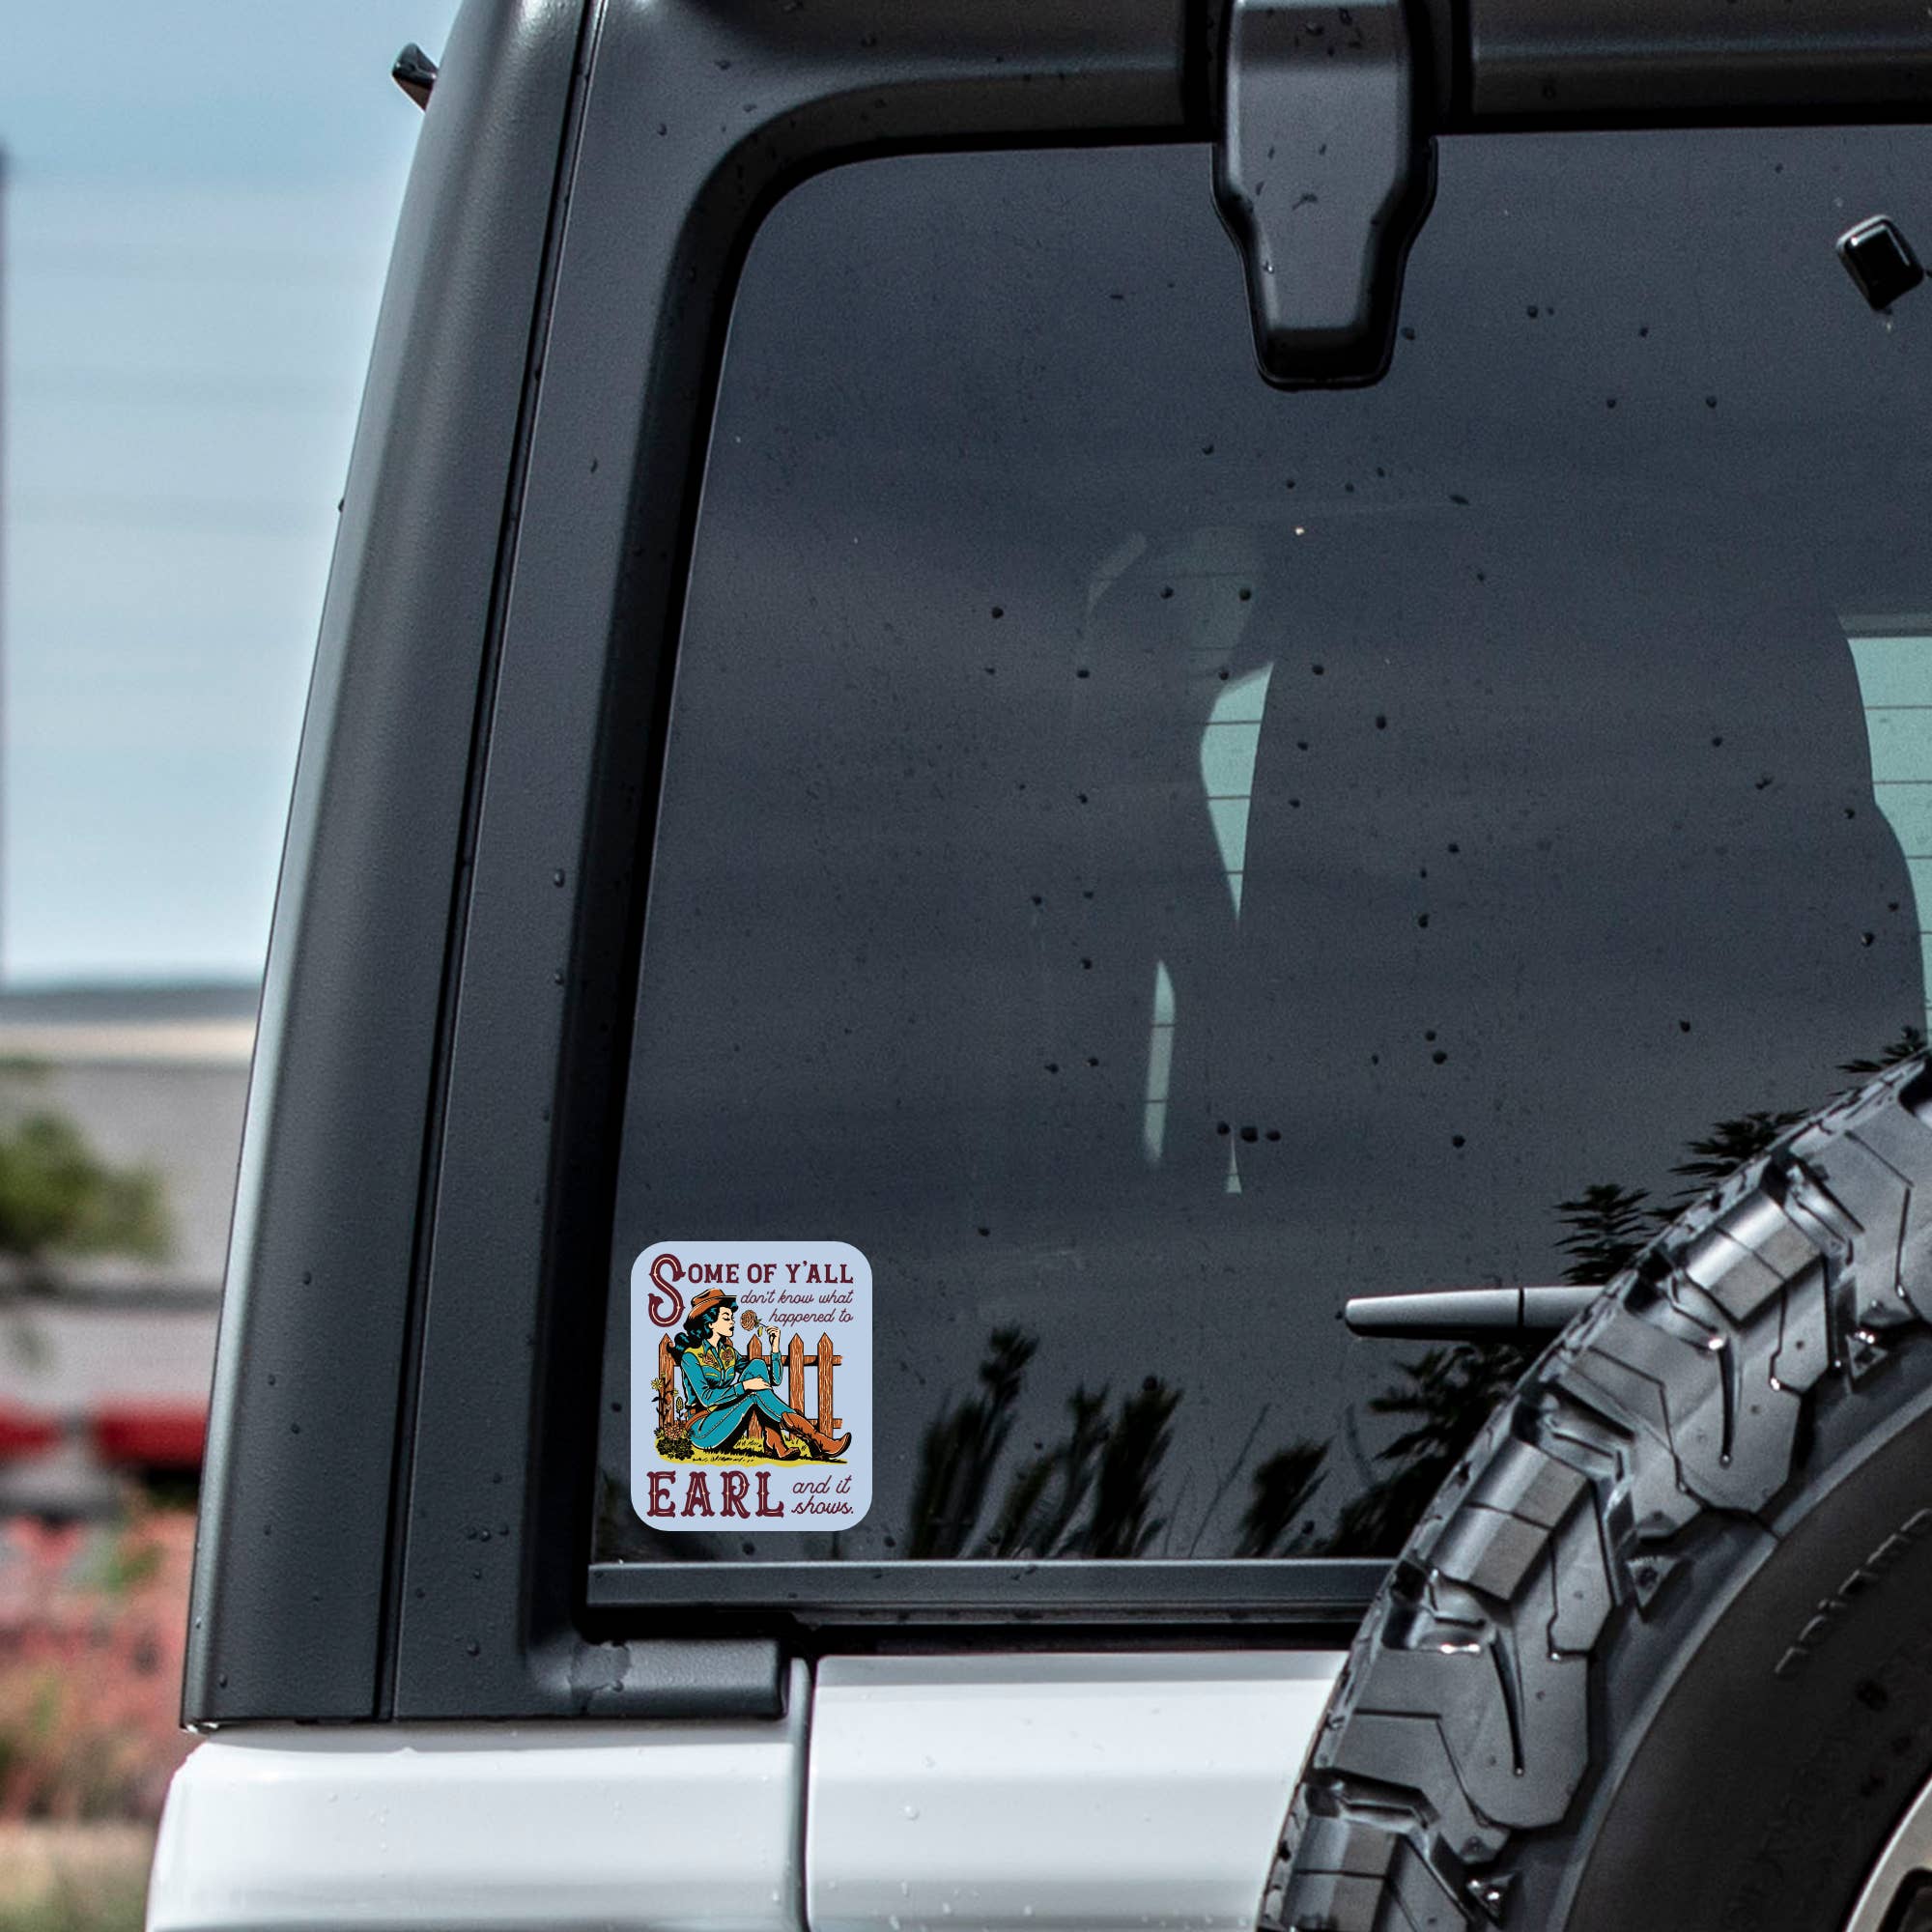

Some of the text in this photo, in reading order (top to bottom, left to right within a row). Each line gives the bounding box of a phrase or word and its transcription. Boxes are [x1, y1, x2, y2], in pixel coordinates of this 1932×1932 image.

[747, 1263, 778, 1284] OF
[778, 1290, 815, 1304] know
[818, 1290, 852, 1304] what
[768, 1308, 854, 1327] happened to
[646, 1470, 785, 1519] EARL
[792, 1475, 851, 1494] and it
[791, 1495, 854, 1516] shows.
